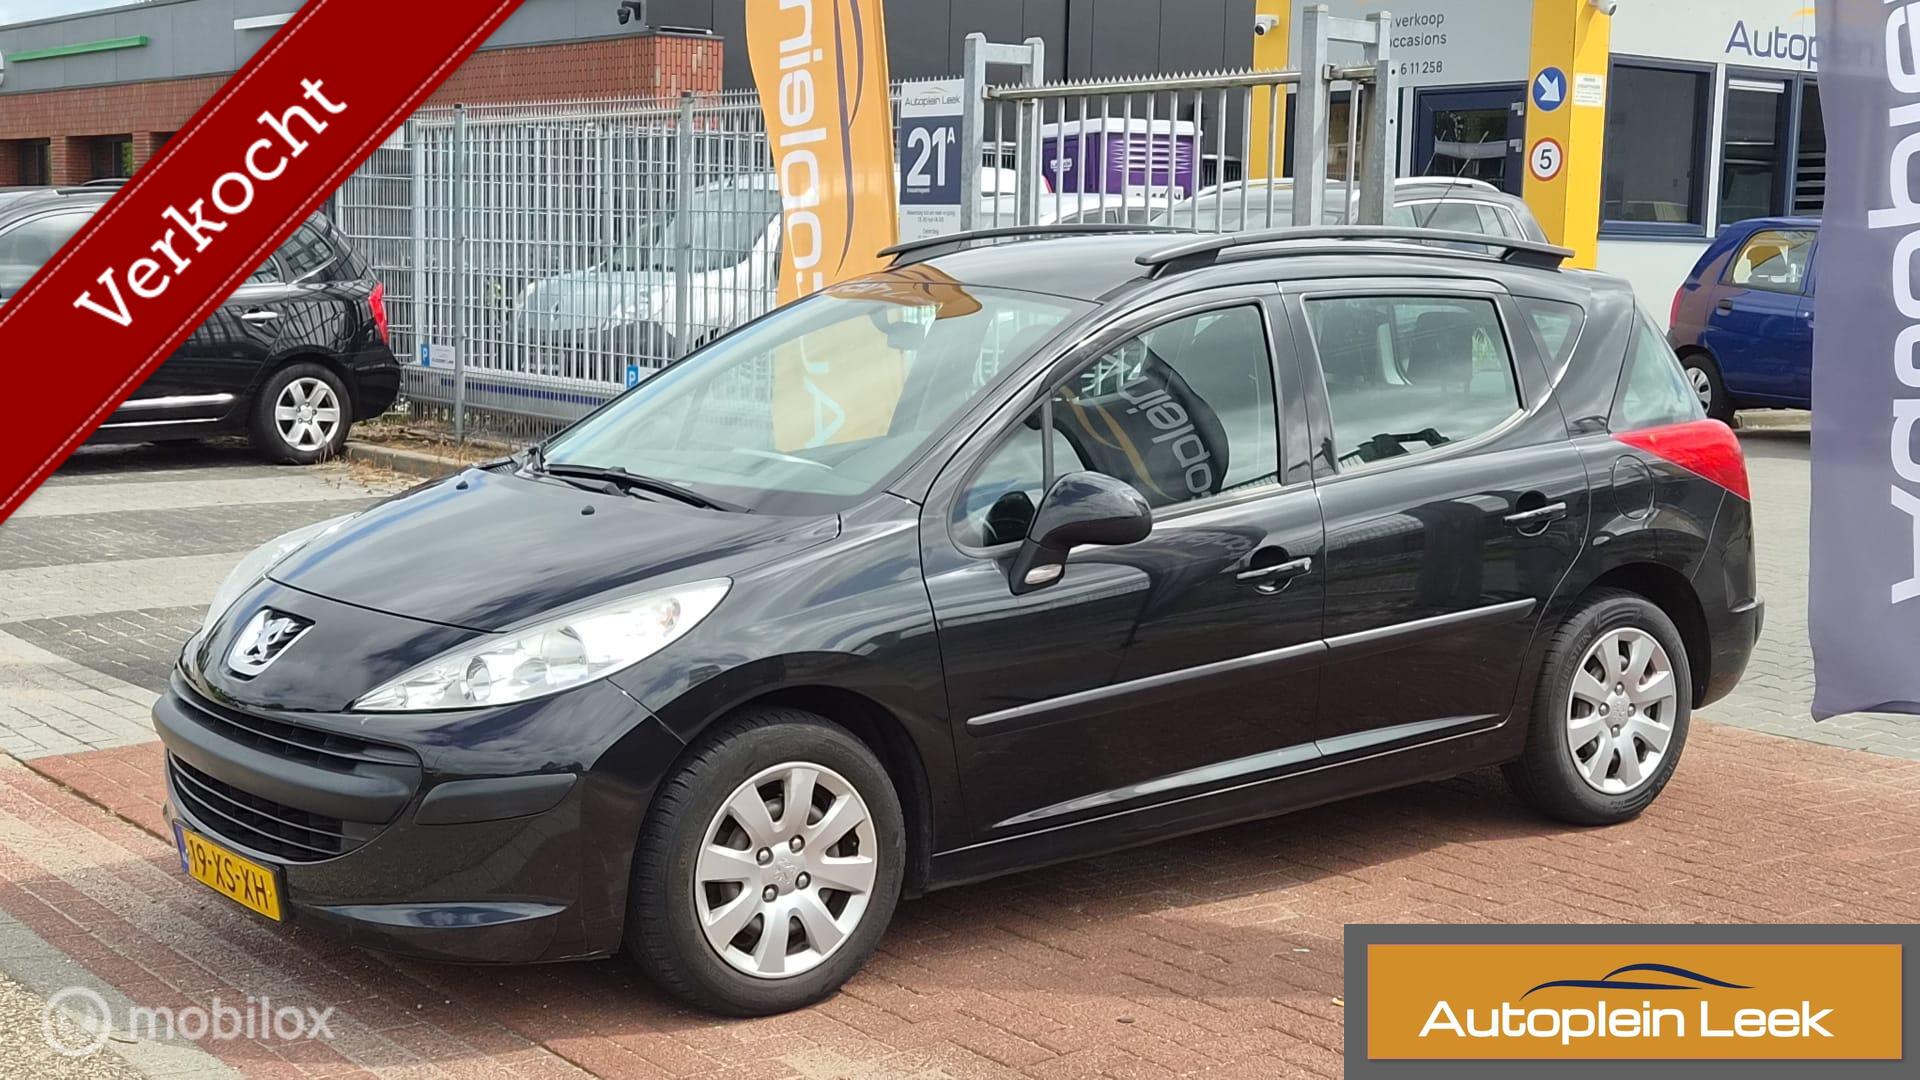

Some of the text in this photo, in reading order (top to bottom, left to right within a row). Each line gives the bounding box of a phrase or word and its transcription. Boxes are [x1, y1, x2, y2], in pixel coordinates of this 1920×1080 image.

[1395, 12, 1445, 28] verkoop
[1389, 32, 1447, 48] ccasions
[1539, 149, 1552, 170] 5
[189, 839, 269, 911] 19-XS-XH
